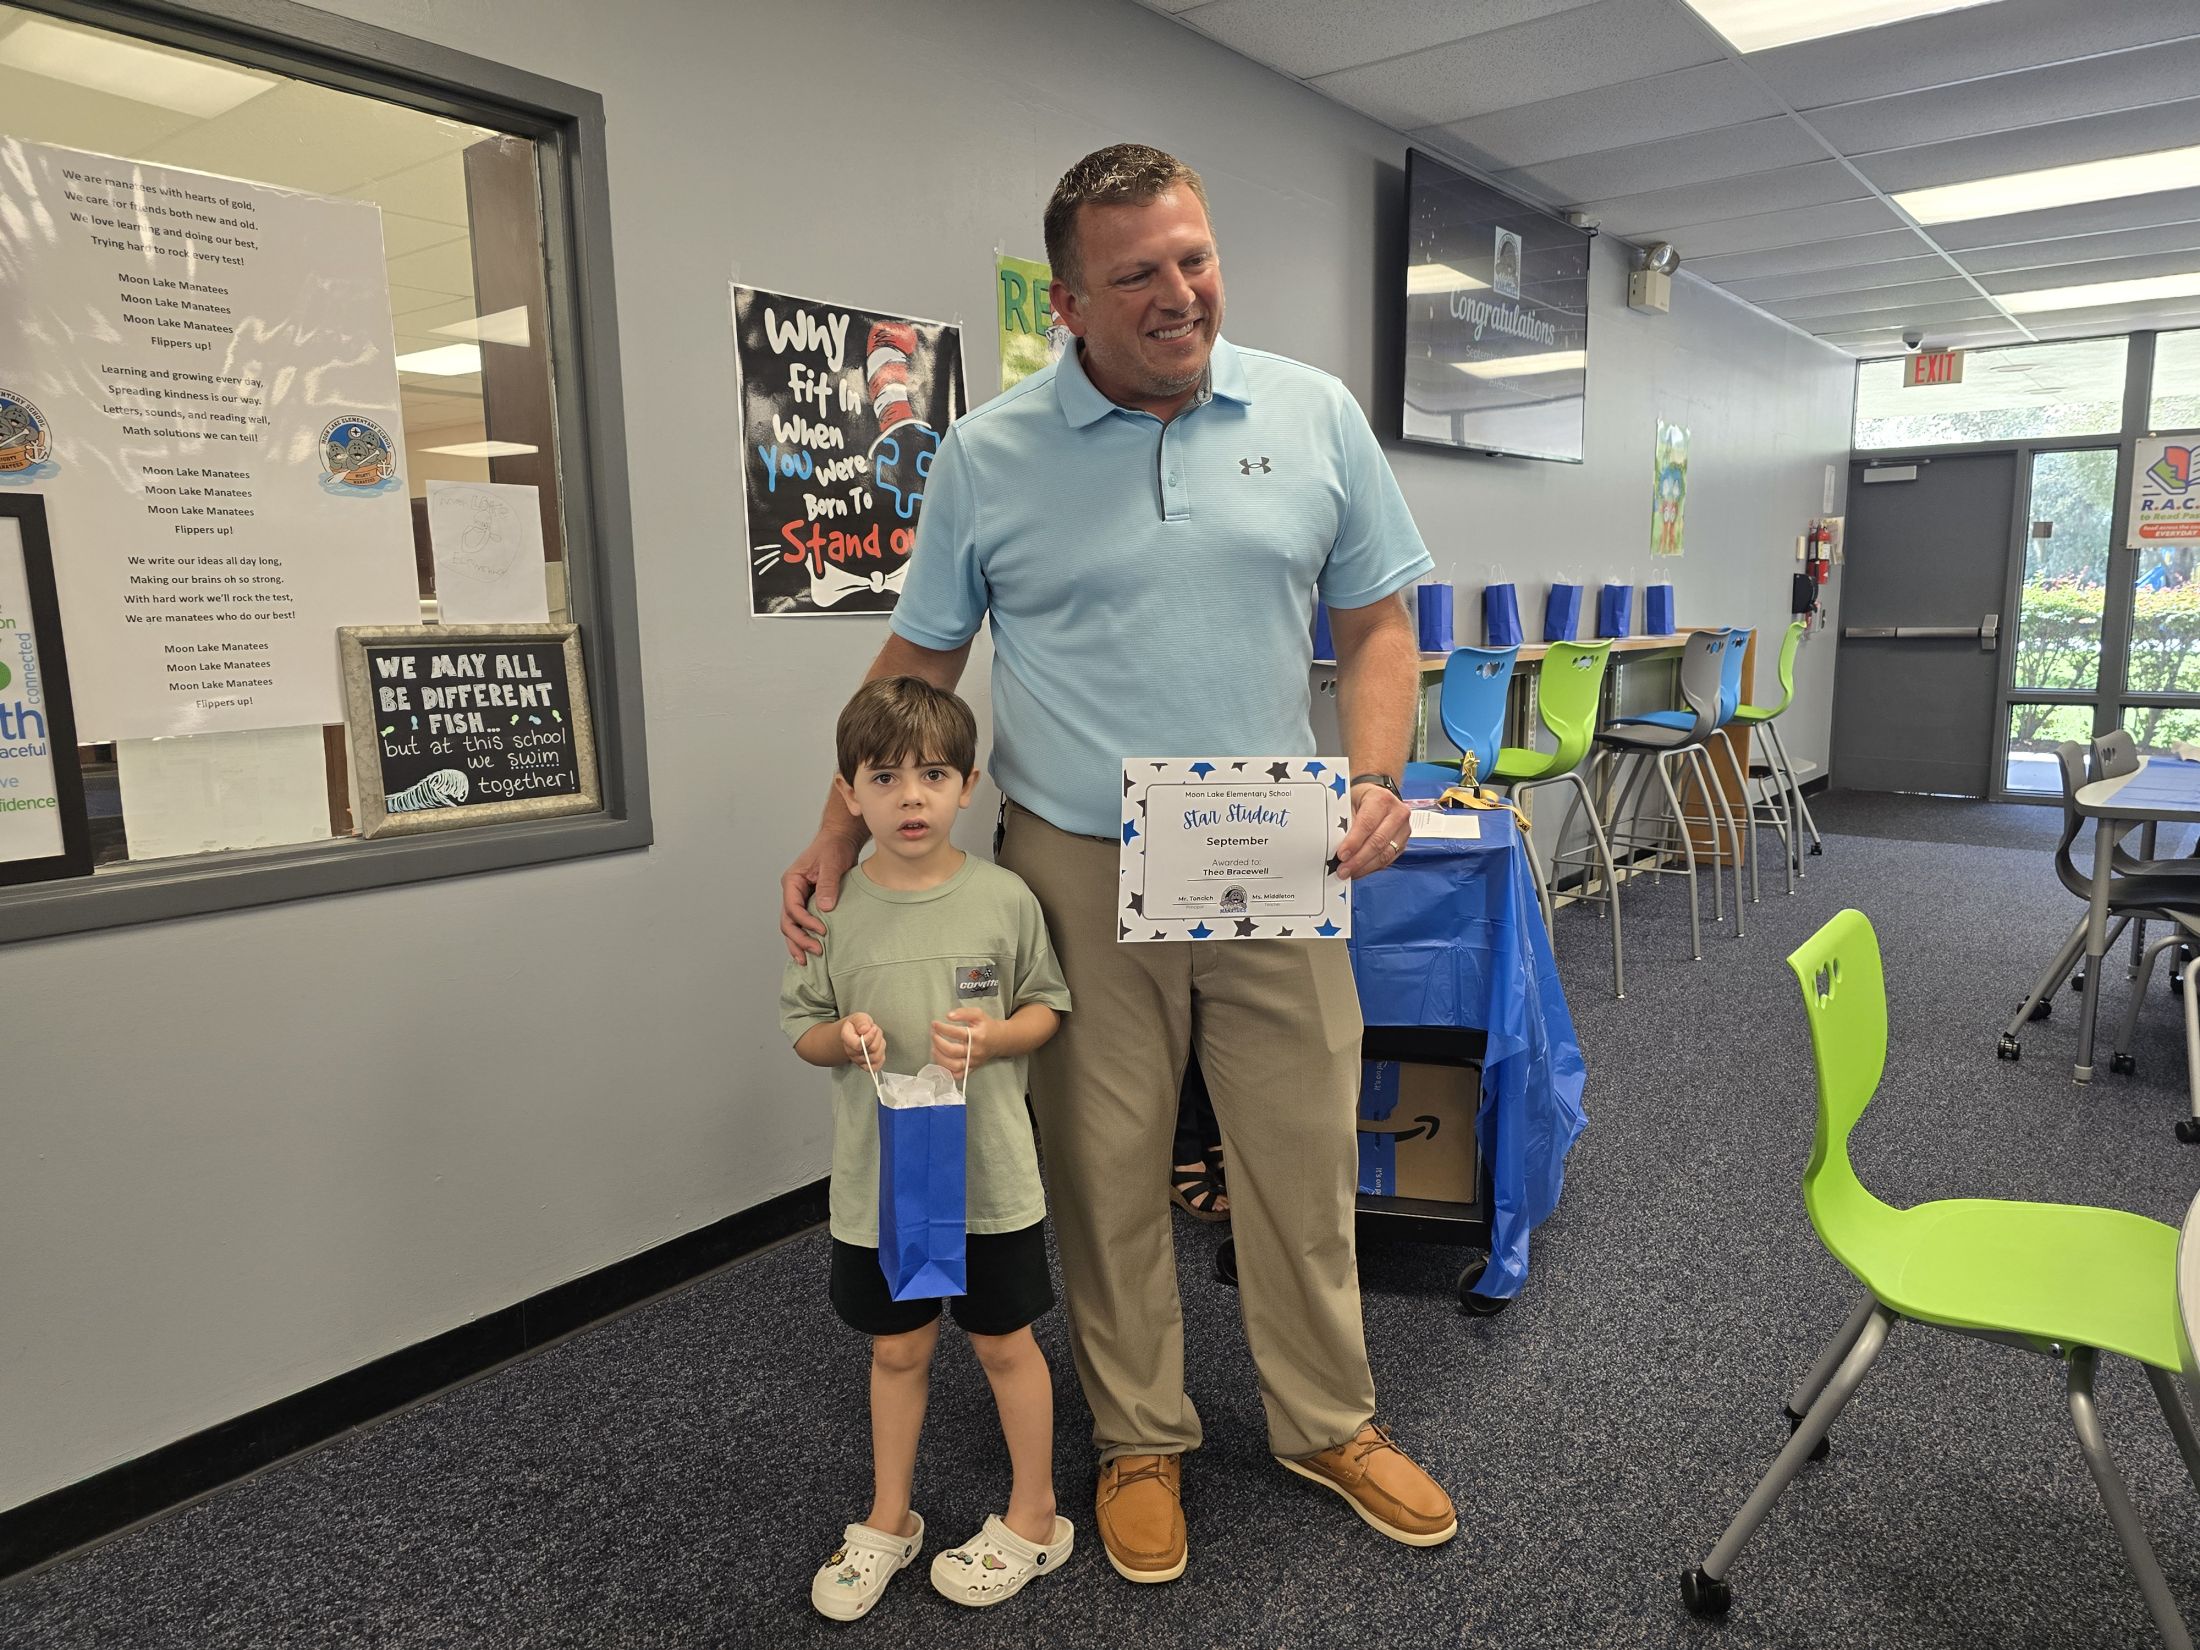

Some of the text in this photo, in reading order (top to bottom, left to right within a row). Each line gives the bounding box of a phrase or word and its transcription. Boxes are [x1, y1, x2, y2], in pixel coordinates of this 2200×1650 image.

[62, 170, 81, 180] We
[84, 176, 102, 184] are
[185, 191, 216, 203] hearts
[232, 201, 255, 211] gold,
[64, 191, 82, 201] We
[86, 197, 108, 206] care
[169, 208, 193, 219] both
[220, 218, 237, 226] and
[240, 221, 258, 230] old.
[91, 215, 114, 227] love
[163, 229, 182, 237] and
[185, 231, 213, 244] doing
[235, 239, 258, 250] best,
[91, 236, 244, 265] Trying to test!
[118, 273, 229, 295] Moon Lake Manatees
[121, 294, 231, 314] Moon Lake Manatees
[124, 314, 234, 333] Moon Lake Manatees
[1450, 287, 1555, 346] Congratulations
[151, 337, 212, 351] Flippers up!
[764, 308, 850, 372] Why
[102, 365, 214, 384] Learning and growing
[1914, 352, 1956, 384] EXIT
[108, 385, 162, 399] Spreading
[164, 390, 209, 400] kindness
[211, 393, 219, 401] is
[839, 379, 861, 415] In
[210, 414, 247, 424] reading
[122, 426, 151, 435] Math
[154, 429, 201, 438] solutions
[240, 434, 258, 442] tell!
[772, 414, 844, 450] When
[142, 466, 250, 478] Moon Lake Manatees
[145, 486, 252, 497] Moon Lake Manatees
[148, 506, 255, 516] Moon Lake Manatees
[803, 487, 872, 521] Born To
[175, 525, 234, 535] Flippers up!
[782, 520, 882, 574] Stand
[198, 556, 224, 565] ideas
[226, 556, 238, 565] all
[240, 556, 257, 566] day
[258, 556, 282, 566] long,
[130, 575, 169, 585] Making
[124, 594, 150, 603] With
[152, 594, 176, 603] hard
[206, 593, 230, 602] we'll
[272, 610, 296, 619] best!
[164, 642, 269, 653] Moon Lake Manatees
[16, 632, 40, 704] connected
[376, 654, 542, 679] WE MAY ALL
[202, 680, 224, 689] Lake
[226, 678, 273, 687] Manatees
[196, 696, 253, 708] Flippers up!
[379, 683, 552, 712] BE DIFFERENT
[385, 728, 566, 757] but at this school
[467, 749, 560, 769] we swim
[1226, 790, 1267, 799] Elementary
[1184, 804, 1291, 830] Star Student
[1206, 836, 1268, 847] September
